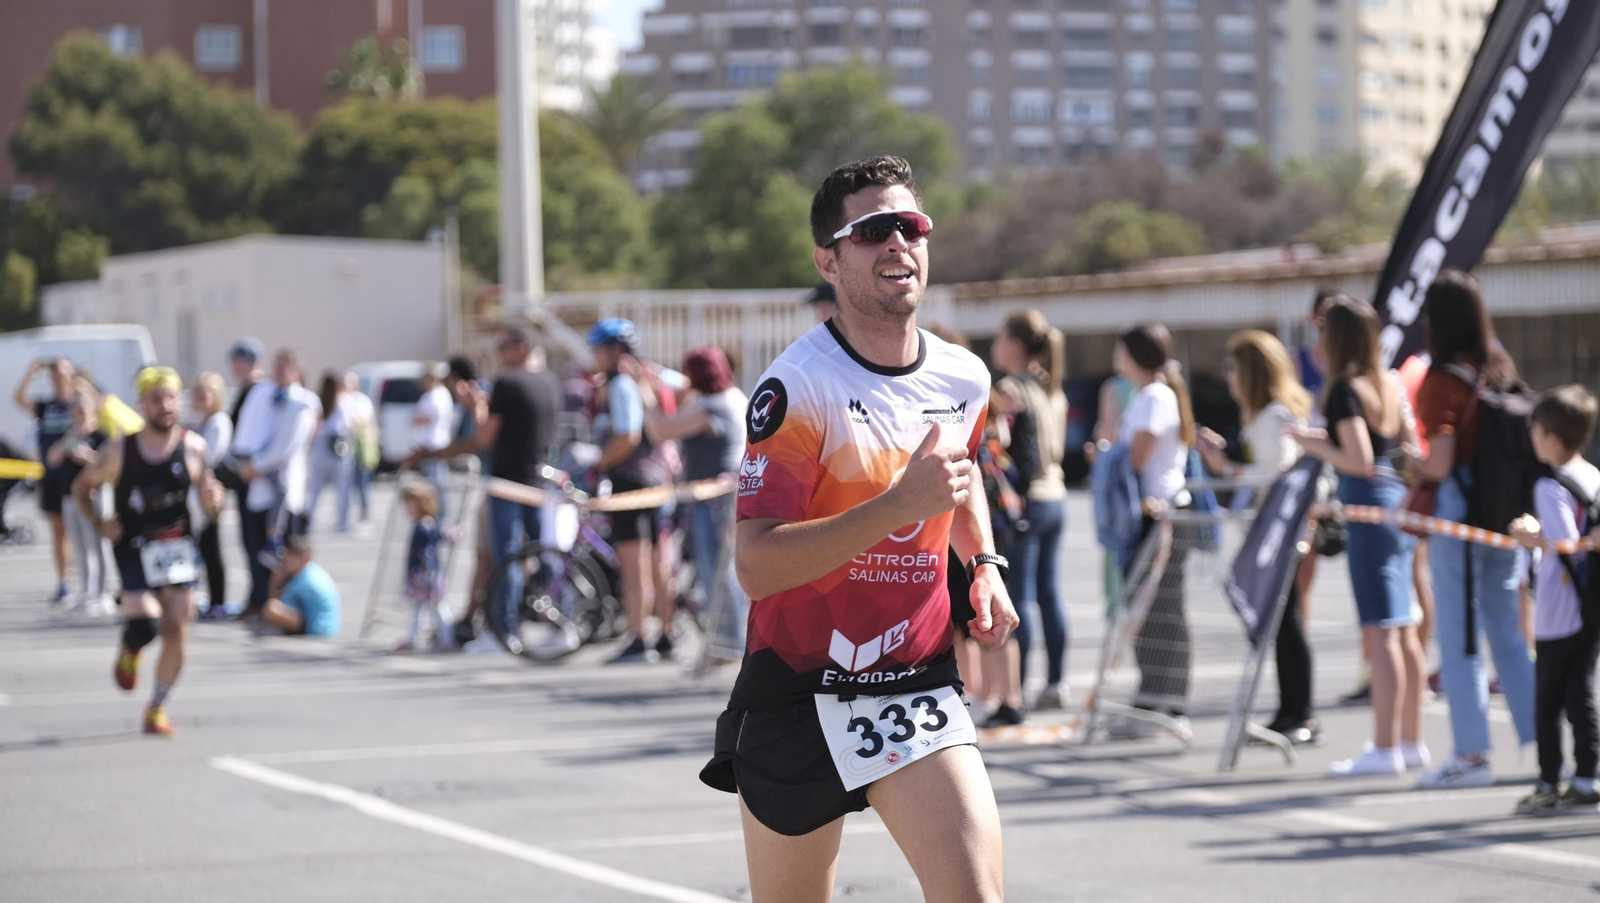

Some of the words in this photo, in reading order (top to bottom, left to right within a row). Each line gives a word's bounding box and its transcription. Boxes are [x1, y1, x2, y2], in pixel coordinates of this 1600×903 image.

[951, 415, 966, 424] CAR
[848, 567, 908, 584] SALINAS
[912, 570, 936, 584] CAR
[847, 695, 949, 758] 333
